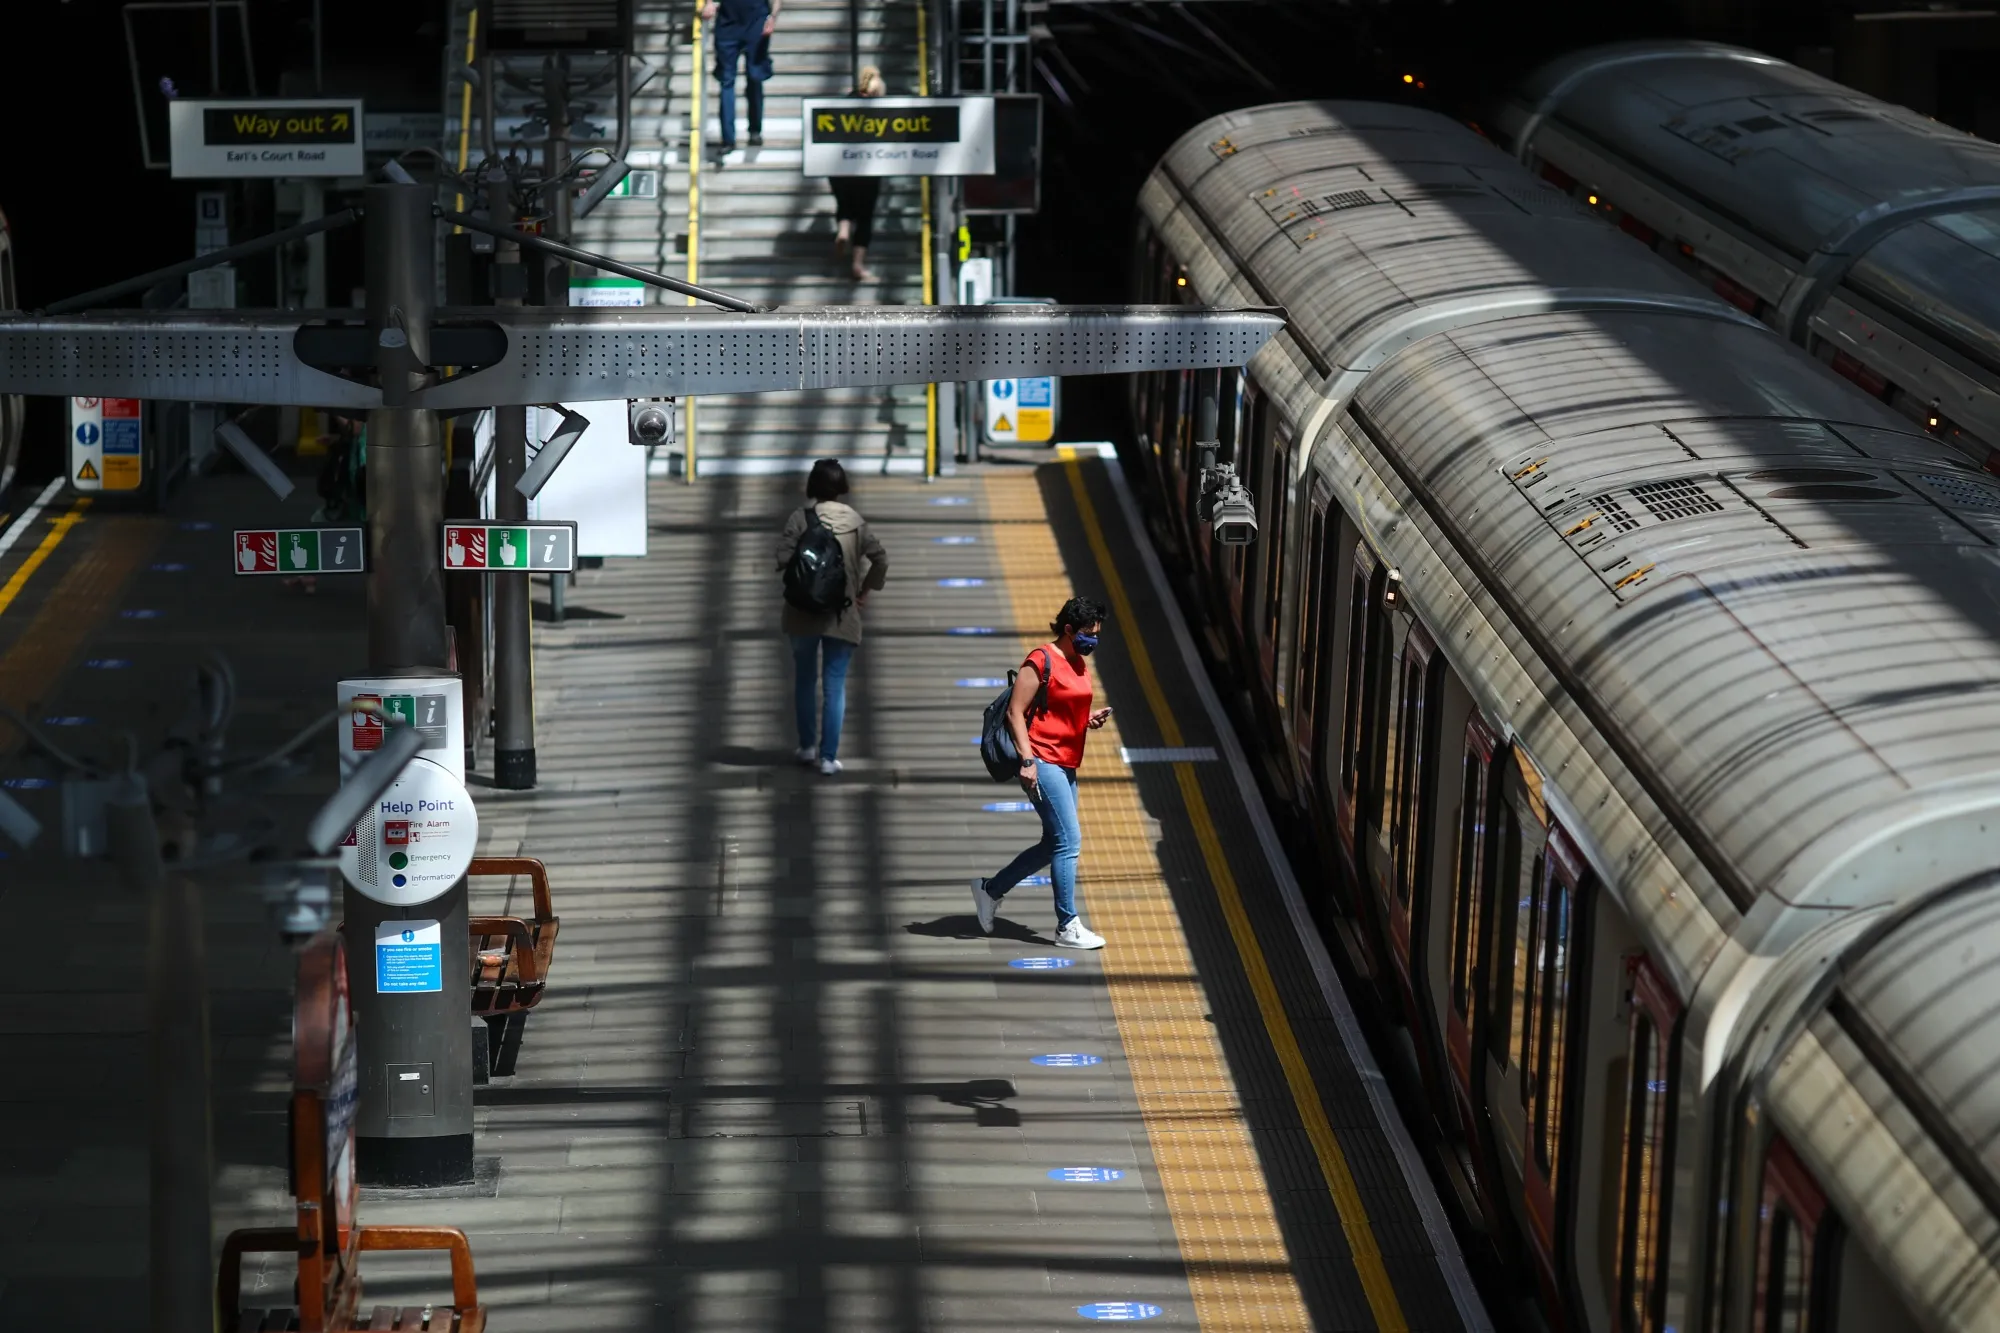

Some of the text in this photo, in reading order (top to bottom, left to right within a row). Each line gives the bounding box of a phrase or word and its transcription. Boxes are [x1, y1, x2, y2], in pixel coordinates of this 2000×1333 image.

[233, 113, 325, 138] Way out
[840, 113, 932, 138] Way out
[227, 150, 325, 162] Earl's Court Road
[842, 149, 939, 160] Earl's Court Road
[381, 800, 454, 815] Help Point
[409, 820, 450, 829] Fire Alarm
[410, 853, 451, 862] Emergency
[411, 873, 456, 882] Information
